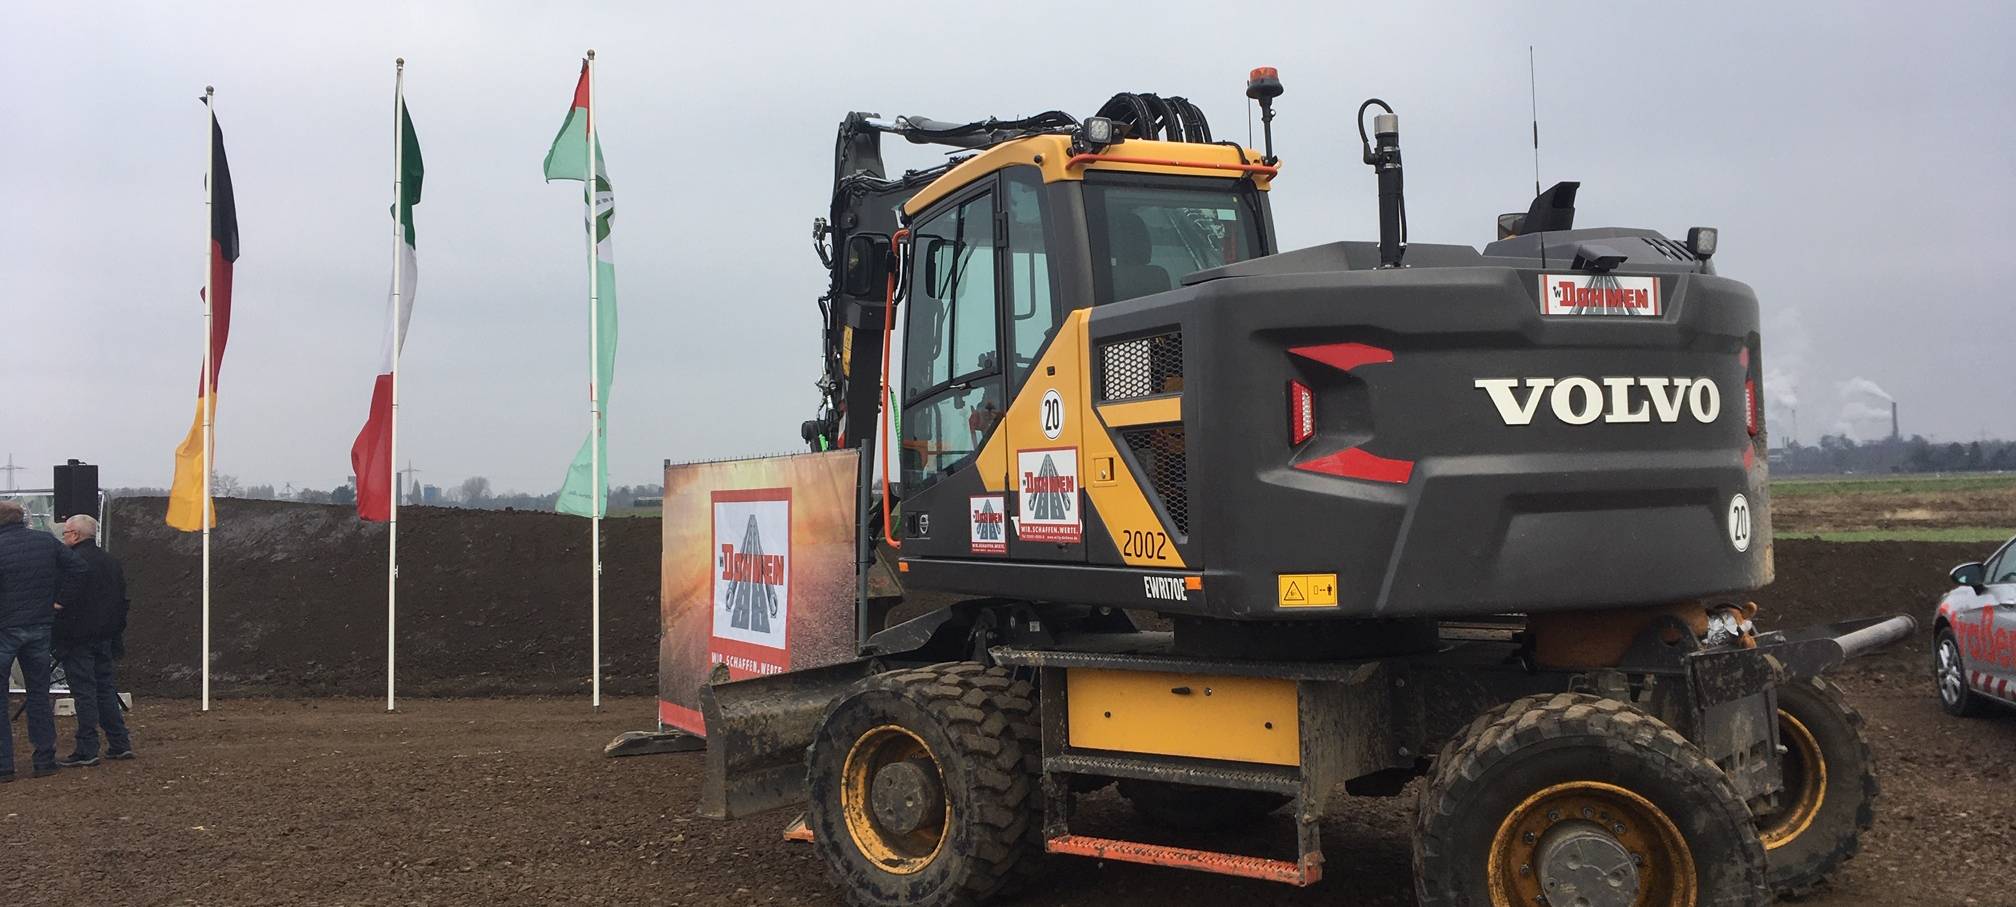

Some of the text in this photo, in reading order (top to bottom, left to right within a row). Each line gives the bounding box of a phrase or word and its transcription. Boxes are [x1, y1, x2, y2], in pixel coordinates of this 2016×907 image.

[1559, 281, 1649, 309] DOHMEN
[1045, 398, 1060, 431] 20
[1475, 376, 1721, 426] VOLVO
[1733, 505, 1748, 541] 20
[1123, 529, 1166, 560] 2002
[721, 543, 785, 586] DOHMEN
[1143, 575, 1188, 601] EWR170E
